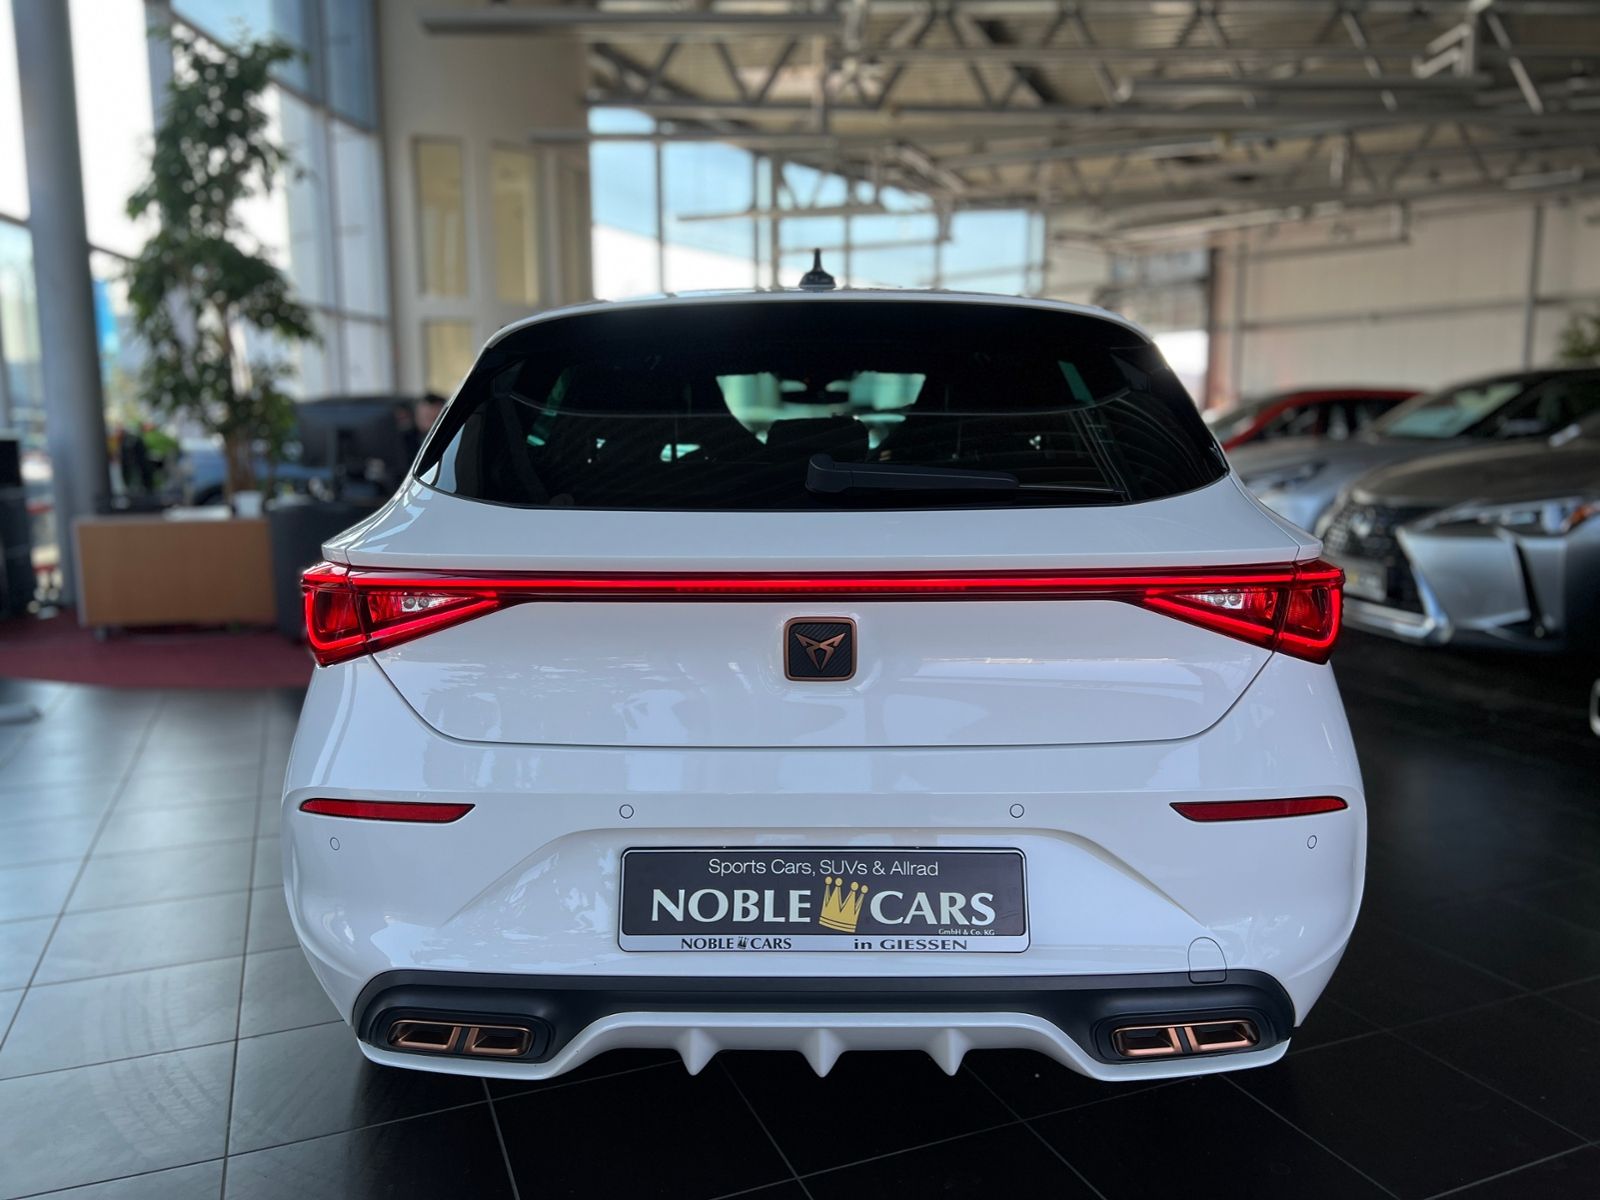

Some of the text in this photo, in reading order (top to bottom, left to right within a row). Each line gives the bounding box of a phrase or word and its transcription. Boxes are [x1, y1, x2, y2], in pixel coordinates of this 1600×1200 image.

[708, 858, 939, 877] Sports Cars, SUVs & Allrad
[651, 888, 996, 926] NOBLE CARS
[938, 928, 961, 936] GmbH
[970, 928, 982, 936] Co.
[681, 937, 792, 950] NOBLE CARS
[854, 938, 968, 950] in GIESSEN
